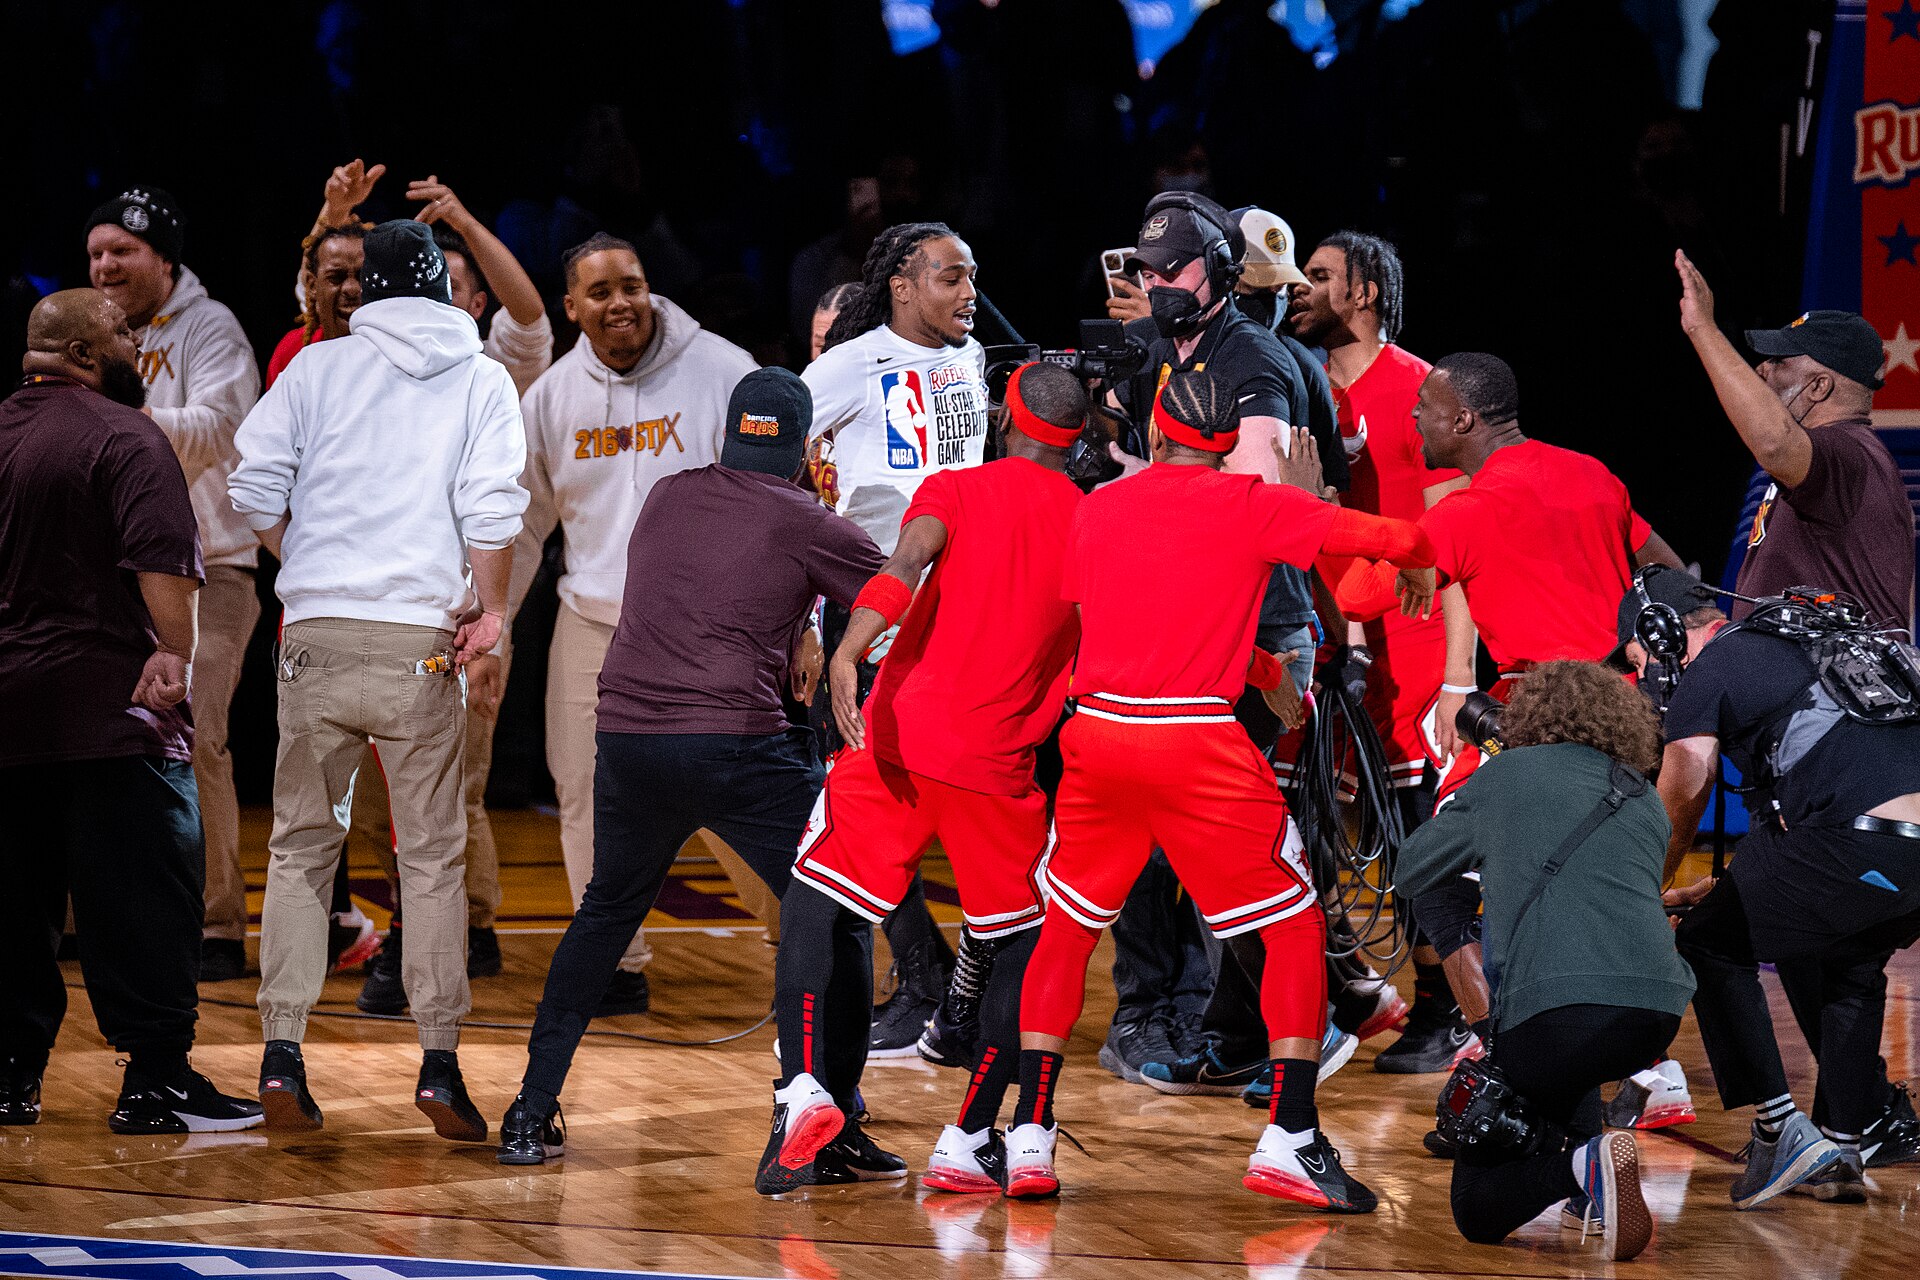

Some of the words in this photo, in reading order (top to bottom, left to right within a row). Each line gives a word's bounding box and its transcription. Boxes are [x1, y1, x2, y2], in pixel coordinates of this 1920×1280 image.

[1857, 106, 1920, 179] RU
[139, 341, 175, 385] TIX
[936, 409, 988, 441] CELEBRIT
[575, 426, 619, 459] 216
[891, 448, 915, 465] NBA
[937, 440, 966, 465] GAME
[1485, 739, 1501, 757] iko
